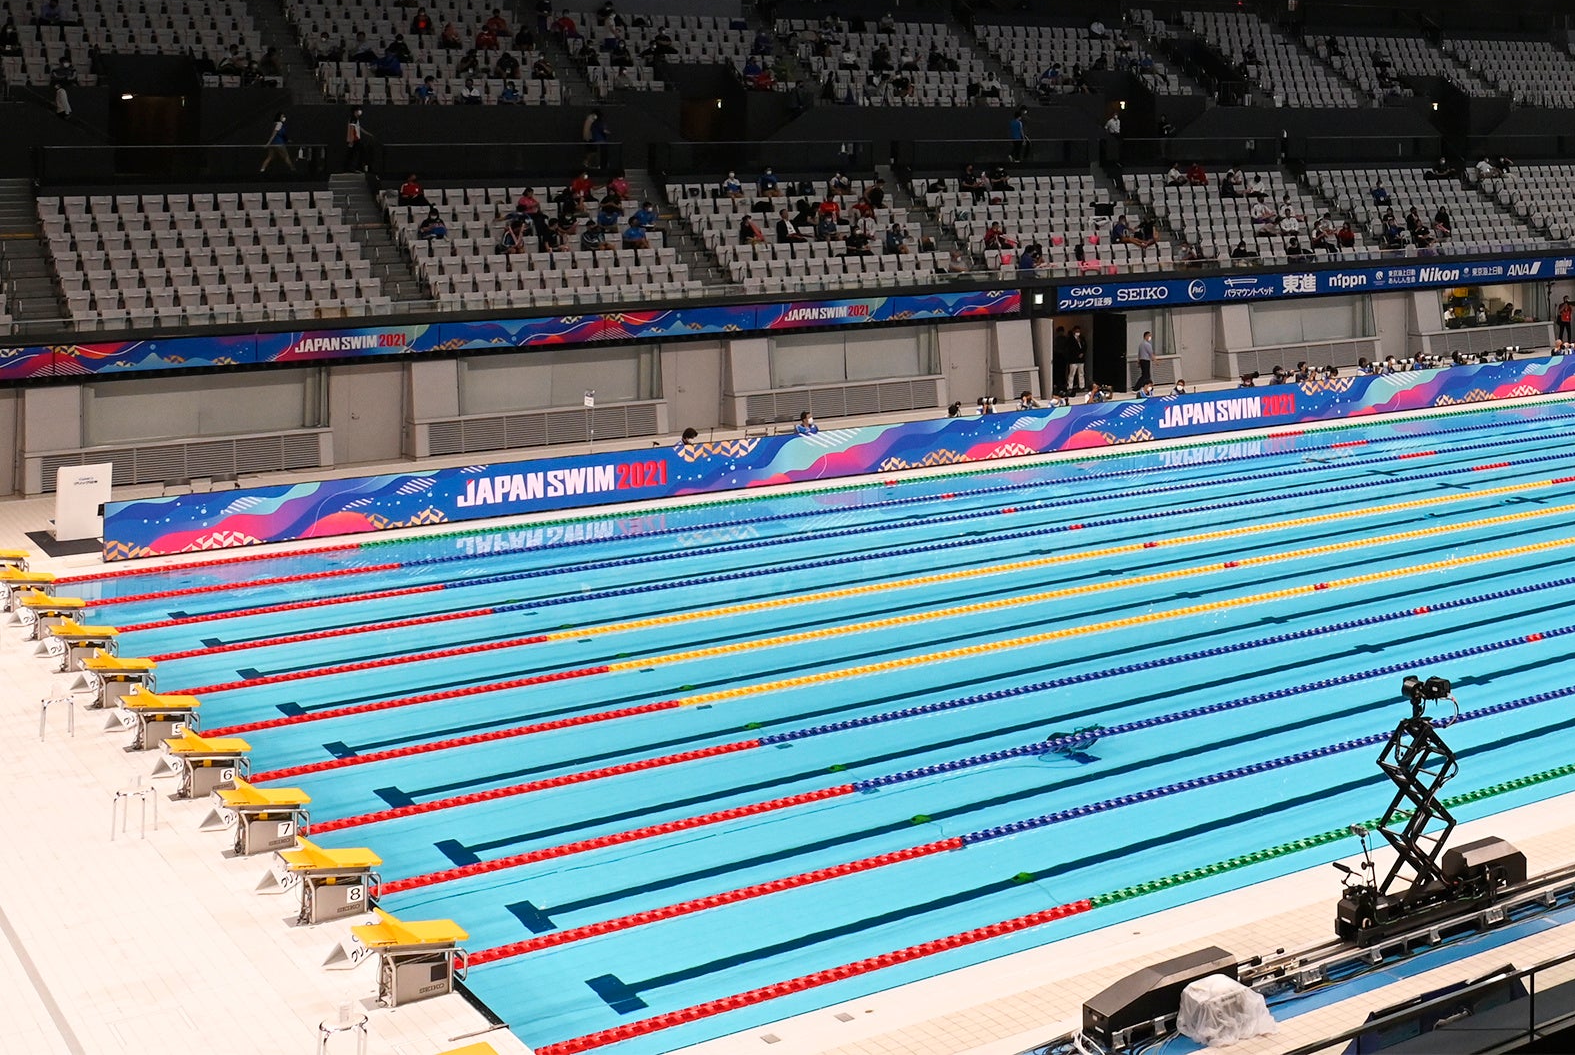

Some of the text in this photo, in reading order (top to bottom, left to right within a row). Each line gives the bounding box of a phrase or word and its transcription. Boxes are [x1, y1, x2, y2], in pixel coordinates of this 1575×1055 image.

[1419, 267, 1460, 283] Nikon
[1507, 263, 1531, 276] ANA
[1282, 272, 1317, 294] 東進
[1329, 272, 1367, 290] nippn
[1071, 286, 1103, 297] GMO
[1117, 286, 1169, 302] SEIKO
[1060, 297, 1113, 309] クリック証券
[784, 304, 869, 322] JAPAN SWIM 2021
[295, 333, 406, 354] JAPAN SWIM 2021
[1159, 392, 1296, 429] JAPAN SWIM 2021
[456, 459, 668, 509] JAPAN SWIM 2021
[223, 770, 233, 781] 6
[282, 823, 291, 835] 7
[350, 887, 361, 901] 8
[419, 982, 445, 995] SEIKO
